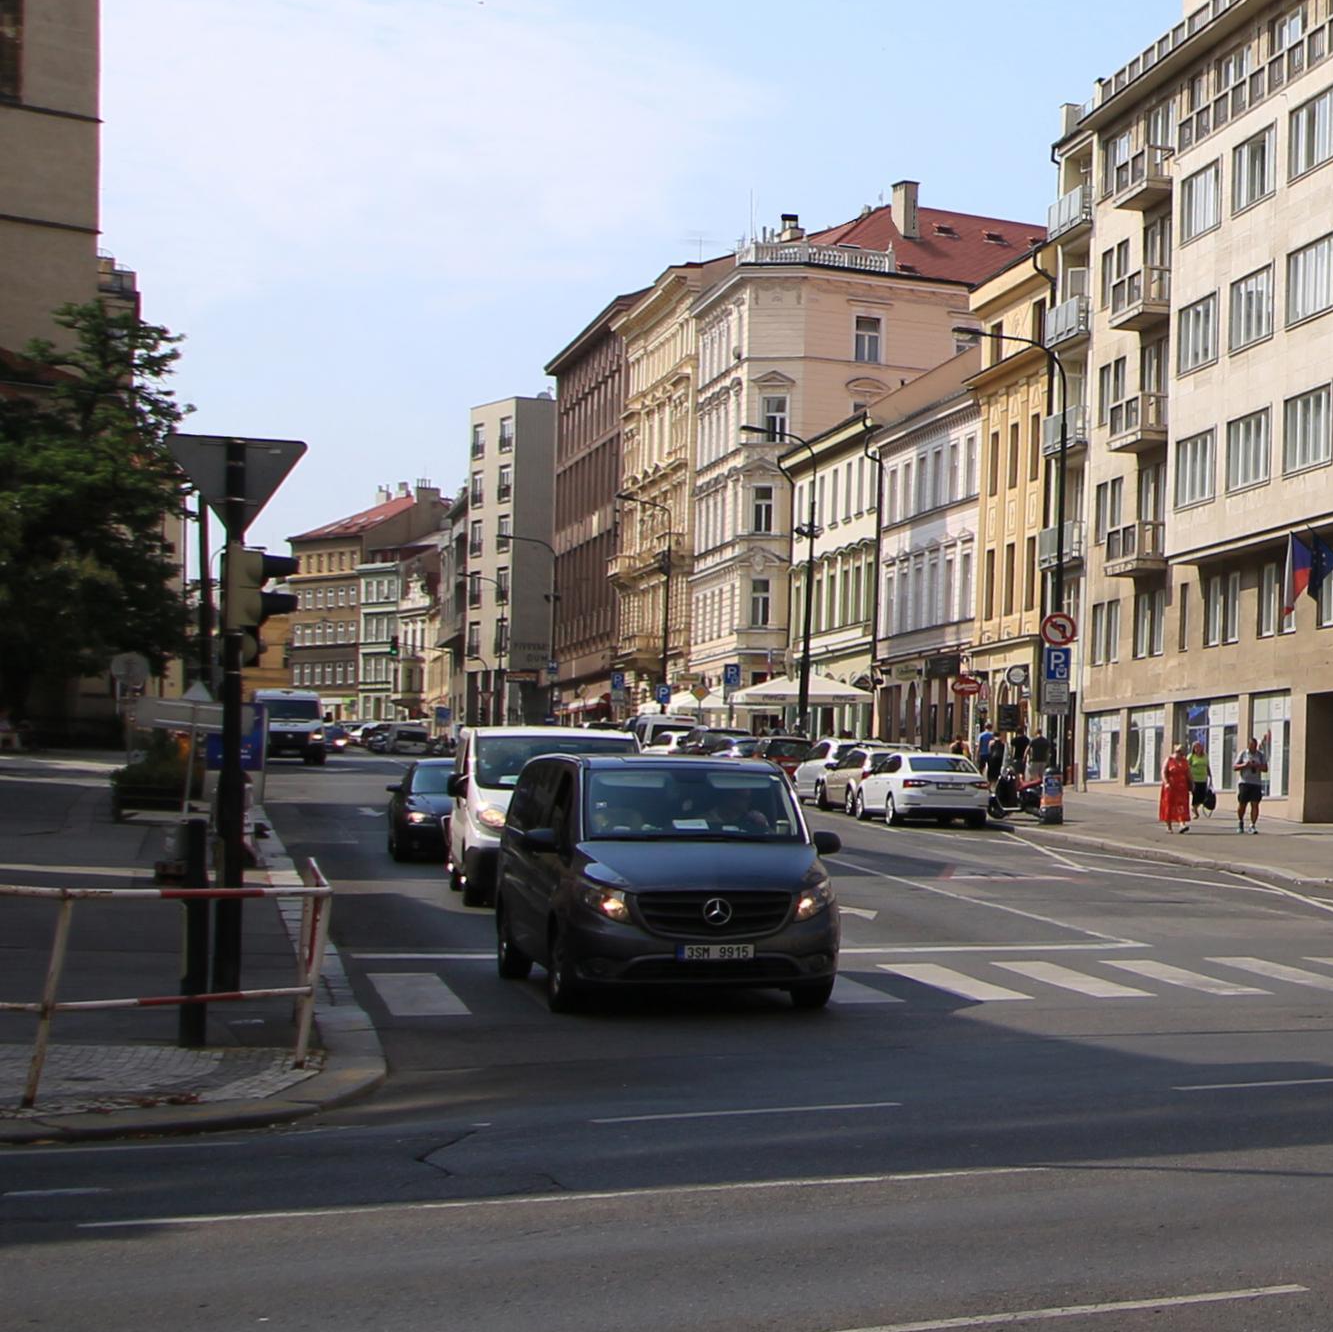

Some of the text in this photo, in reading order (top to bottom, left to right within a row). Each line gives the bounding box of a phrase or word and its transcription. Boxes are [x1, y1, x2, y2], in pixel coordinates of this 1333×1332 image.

[1051, 651, 1065, 671] P
[659, 687, 669, 698] P
[687, 946, 749, 958] 3SM 9915
